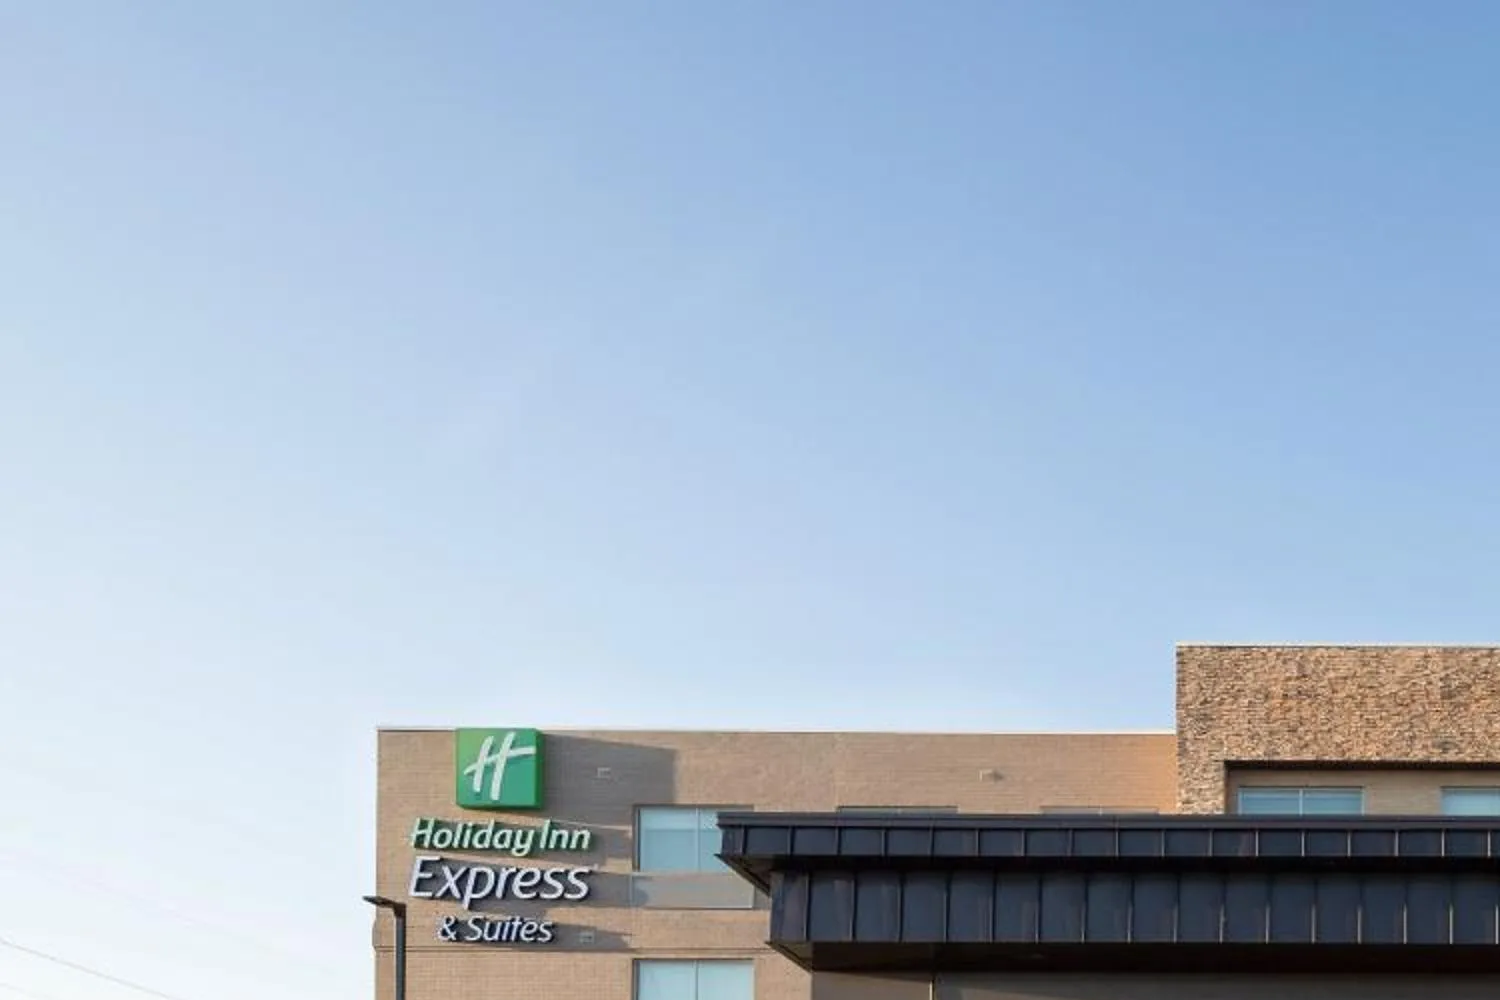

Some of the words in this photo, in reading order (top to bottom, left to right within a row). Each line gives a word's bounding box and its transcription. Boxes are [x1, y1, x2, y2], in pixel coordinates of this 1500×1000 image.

[410, 818, 534, 855] Holiday
[540, 819, 592, 850] Inn
[408, 855, 592, 910] Express
[437, 915, 458, 941] &
[464, 916, 554, 942] Suites
